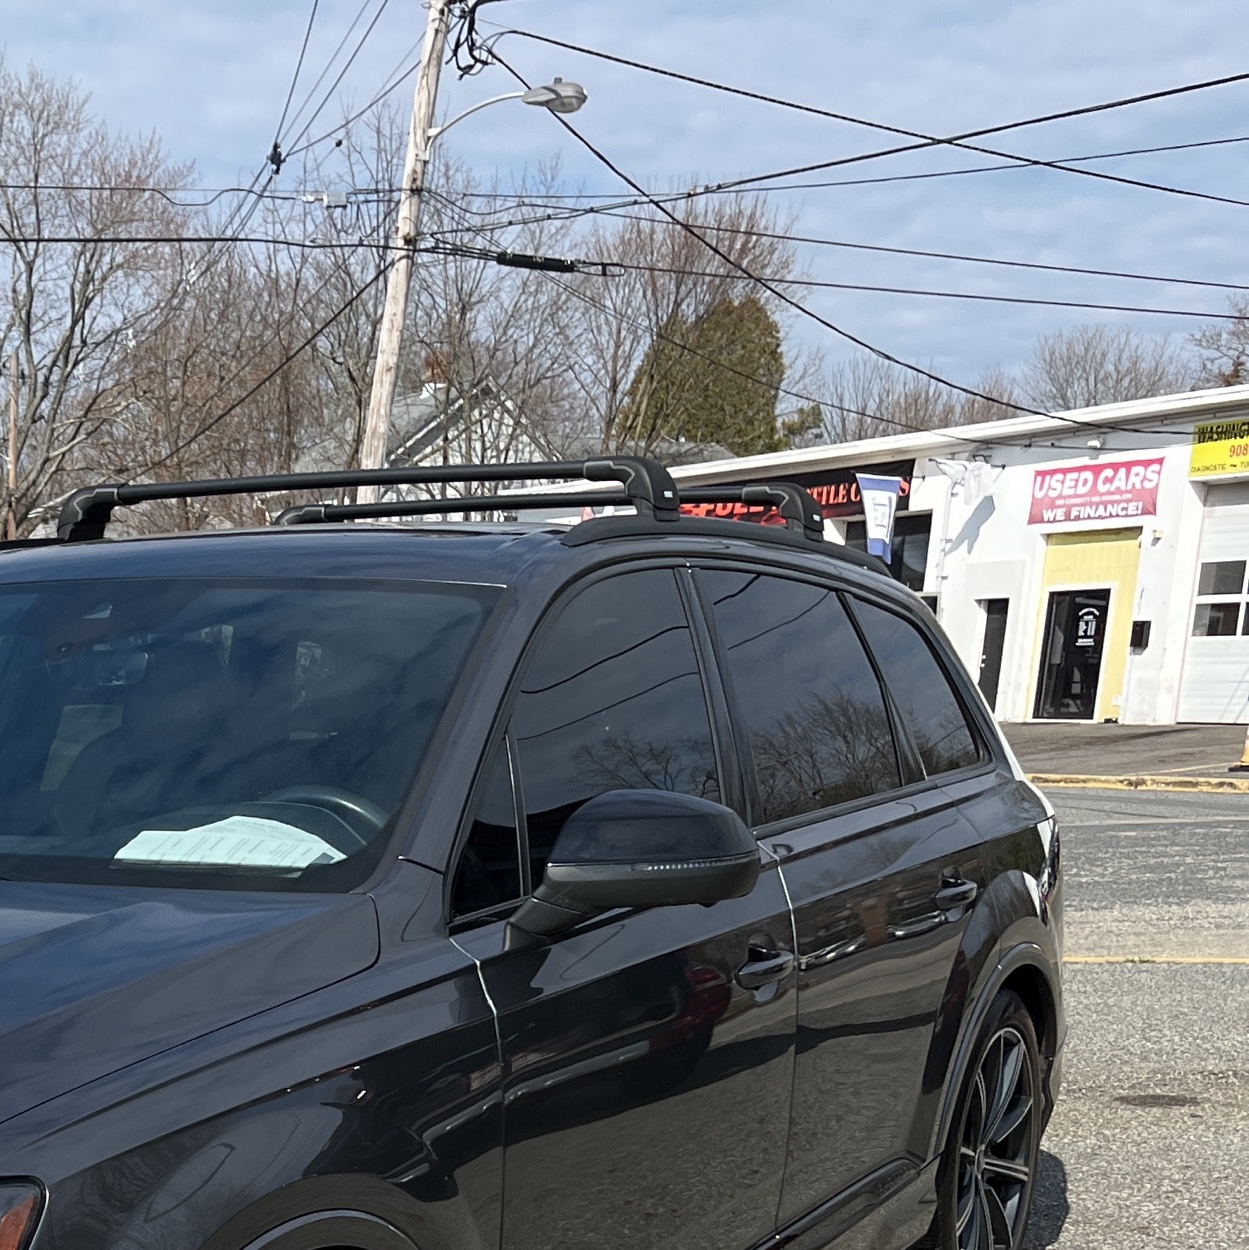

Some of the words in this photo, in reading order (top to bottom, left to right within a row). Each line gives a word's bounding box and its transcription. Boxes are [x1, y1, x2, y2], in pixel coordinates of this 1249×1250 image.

[1229, 443, 1249, 457] 908
[1191, 463, 1227, 473] DIAGNOSTIC
[1034, 470, 1094, 499] USED
[1096, 463, 1161, 493] CARS
[1042, 507, 1066, 522] WE
[1070, 501, 1143, 520] FINANCE!
